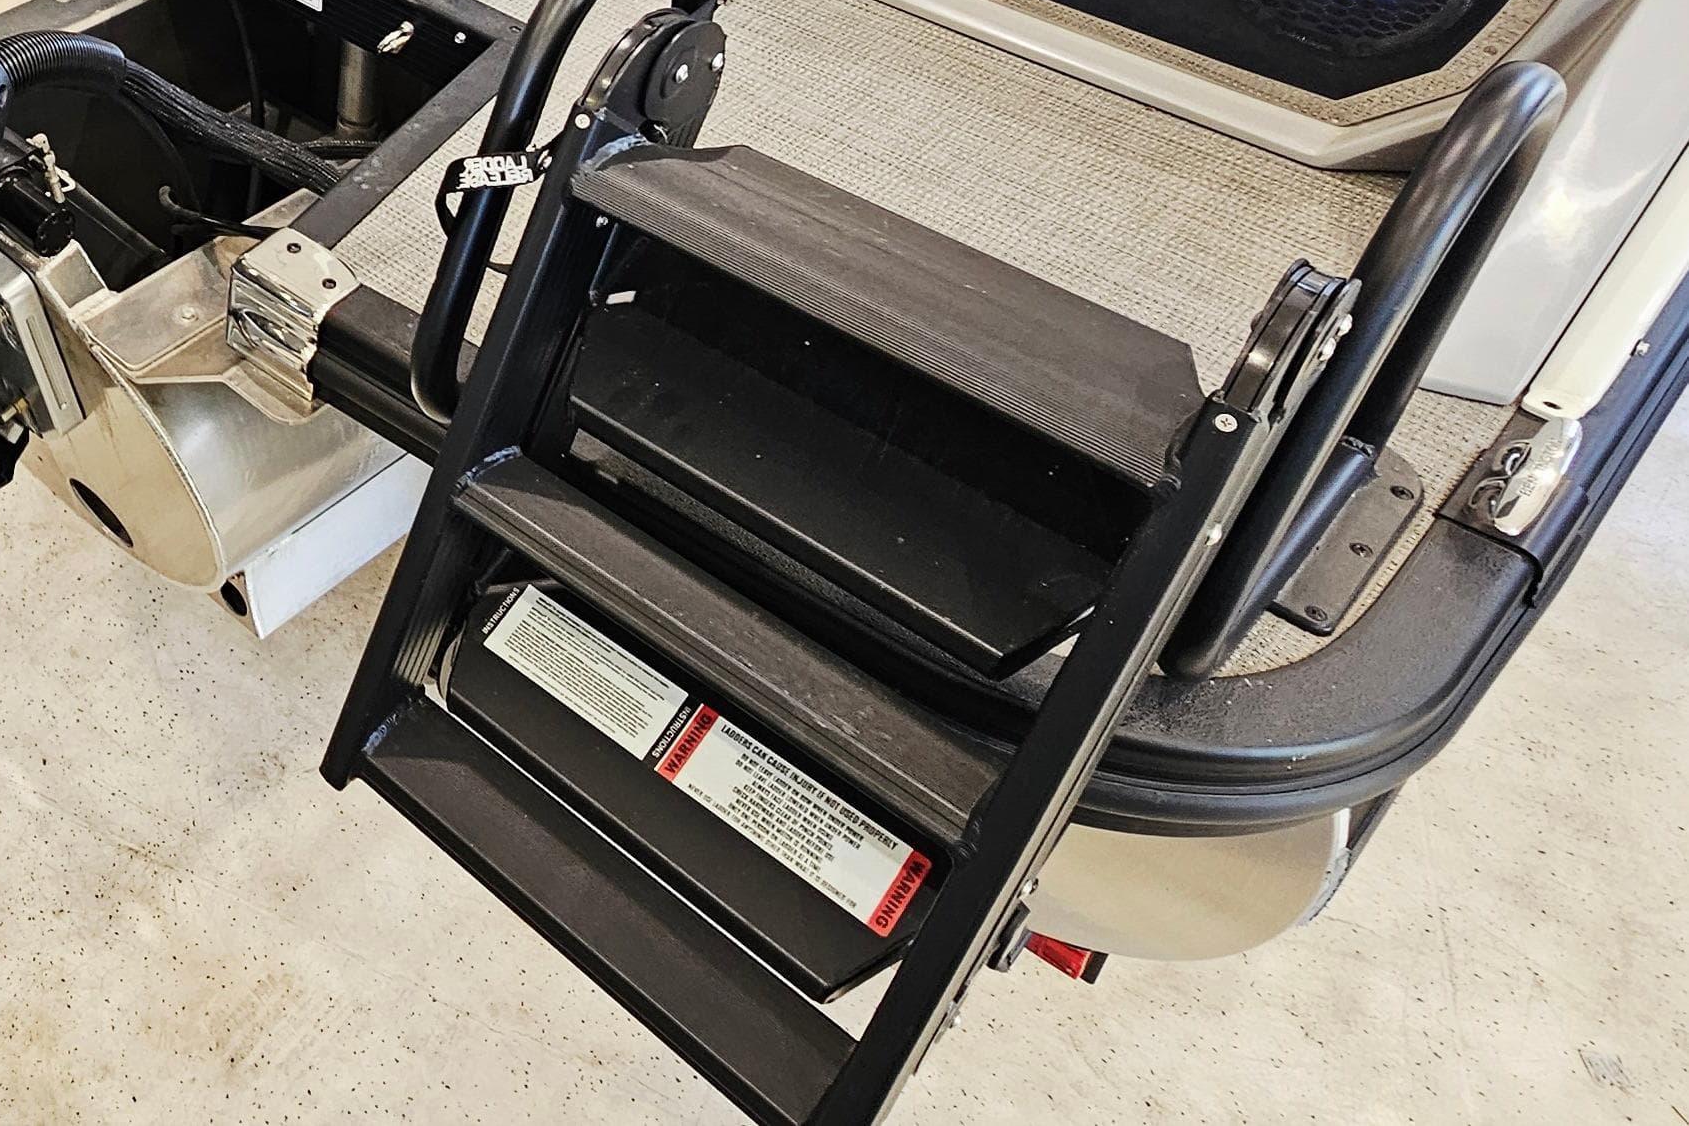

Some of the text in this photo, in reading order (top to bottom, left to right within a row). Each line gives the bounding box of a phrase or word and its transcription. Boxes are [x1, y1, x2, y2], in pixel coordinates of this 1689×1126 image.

[481, 587, 520, 634] INSTRUCTIONS
[651, 706, 692, 758] INSTRUCTIONS
[664, 713, 714, 774] WARNING
[874, 860, 926, 928] WARNING
